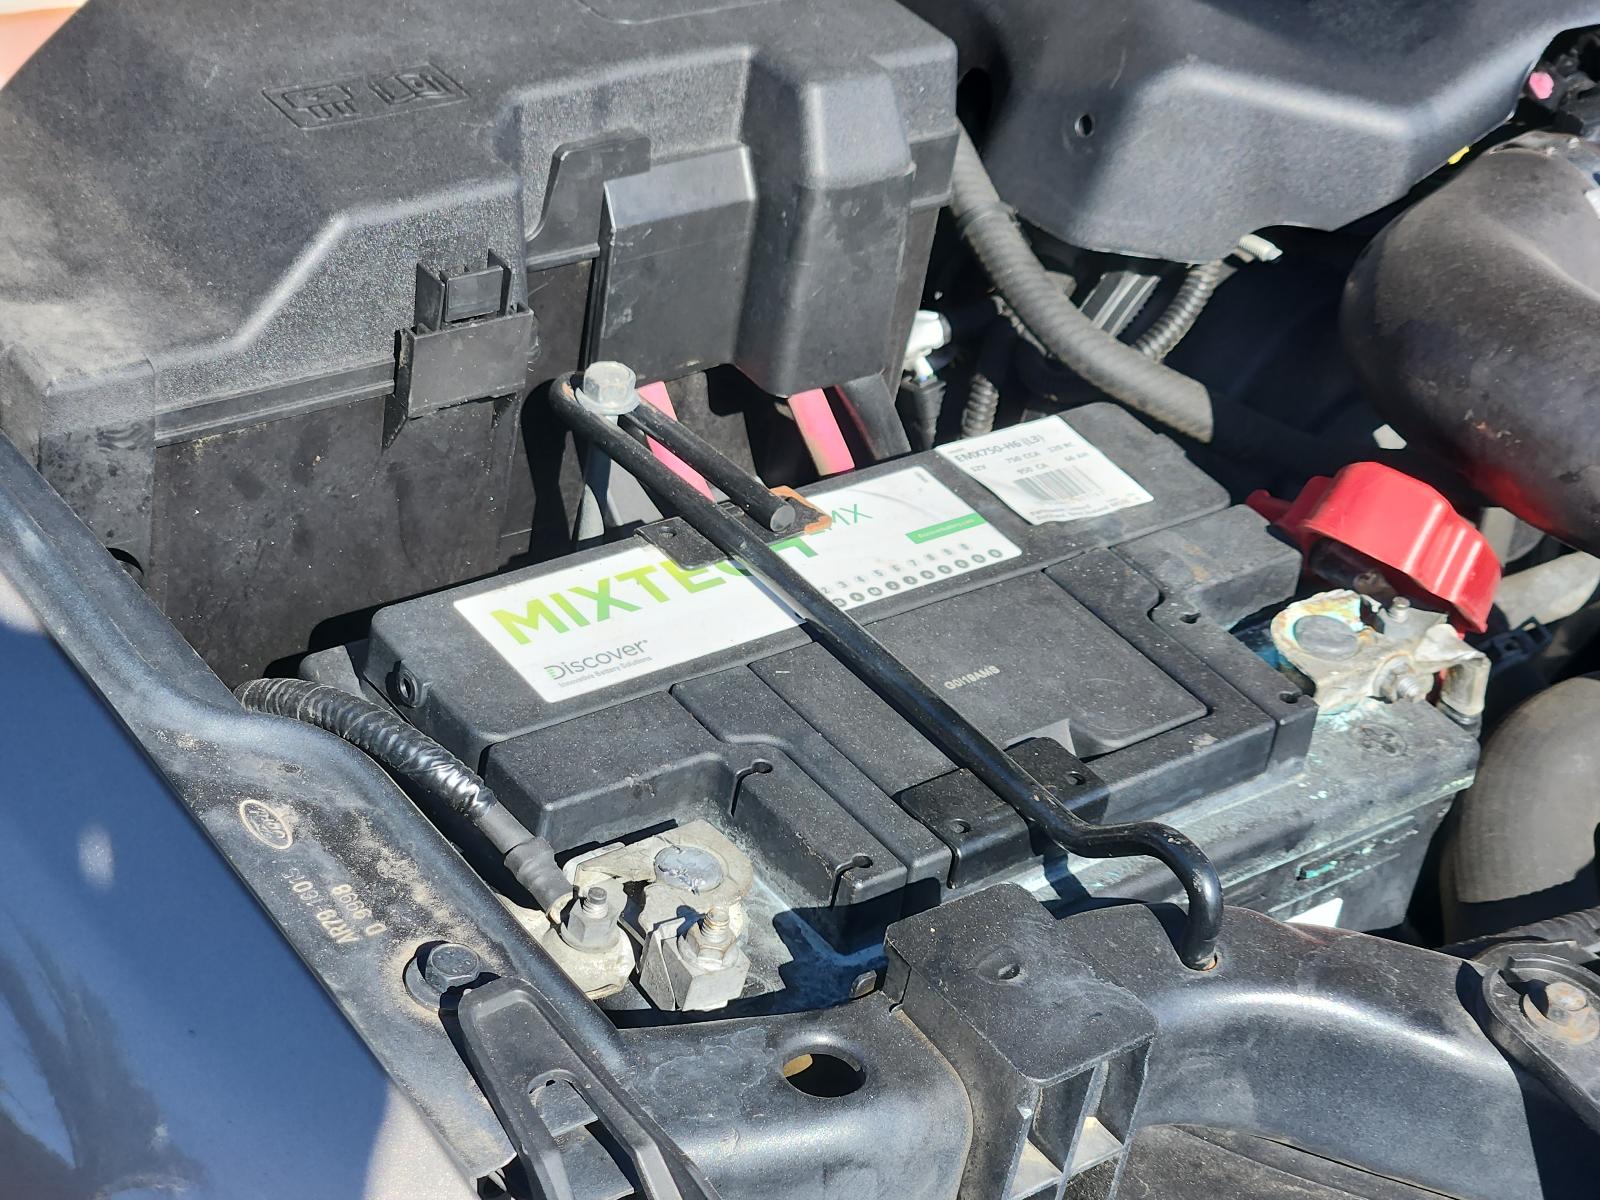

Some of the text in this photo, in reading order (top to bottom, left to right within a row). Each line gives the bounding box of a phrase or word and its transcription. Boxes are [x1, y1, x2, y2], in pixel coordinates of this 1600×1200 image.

[954, 434, 1045, 463] EMX750-H6 (L3)
[543, 640, 646, 680] Discover
